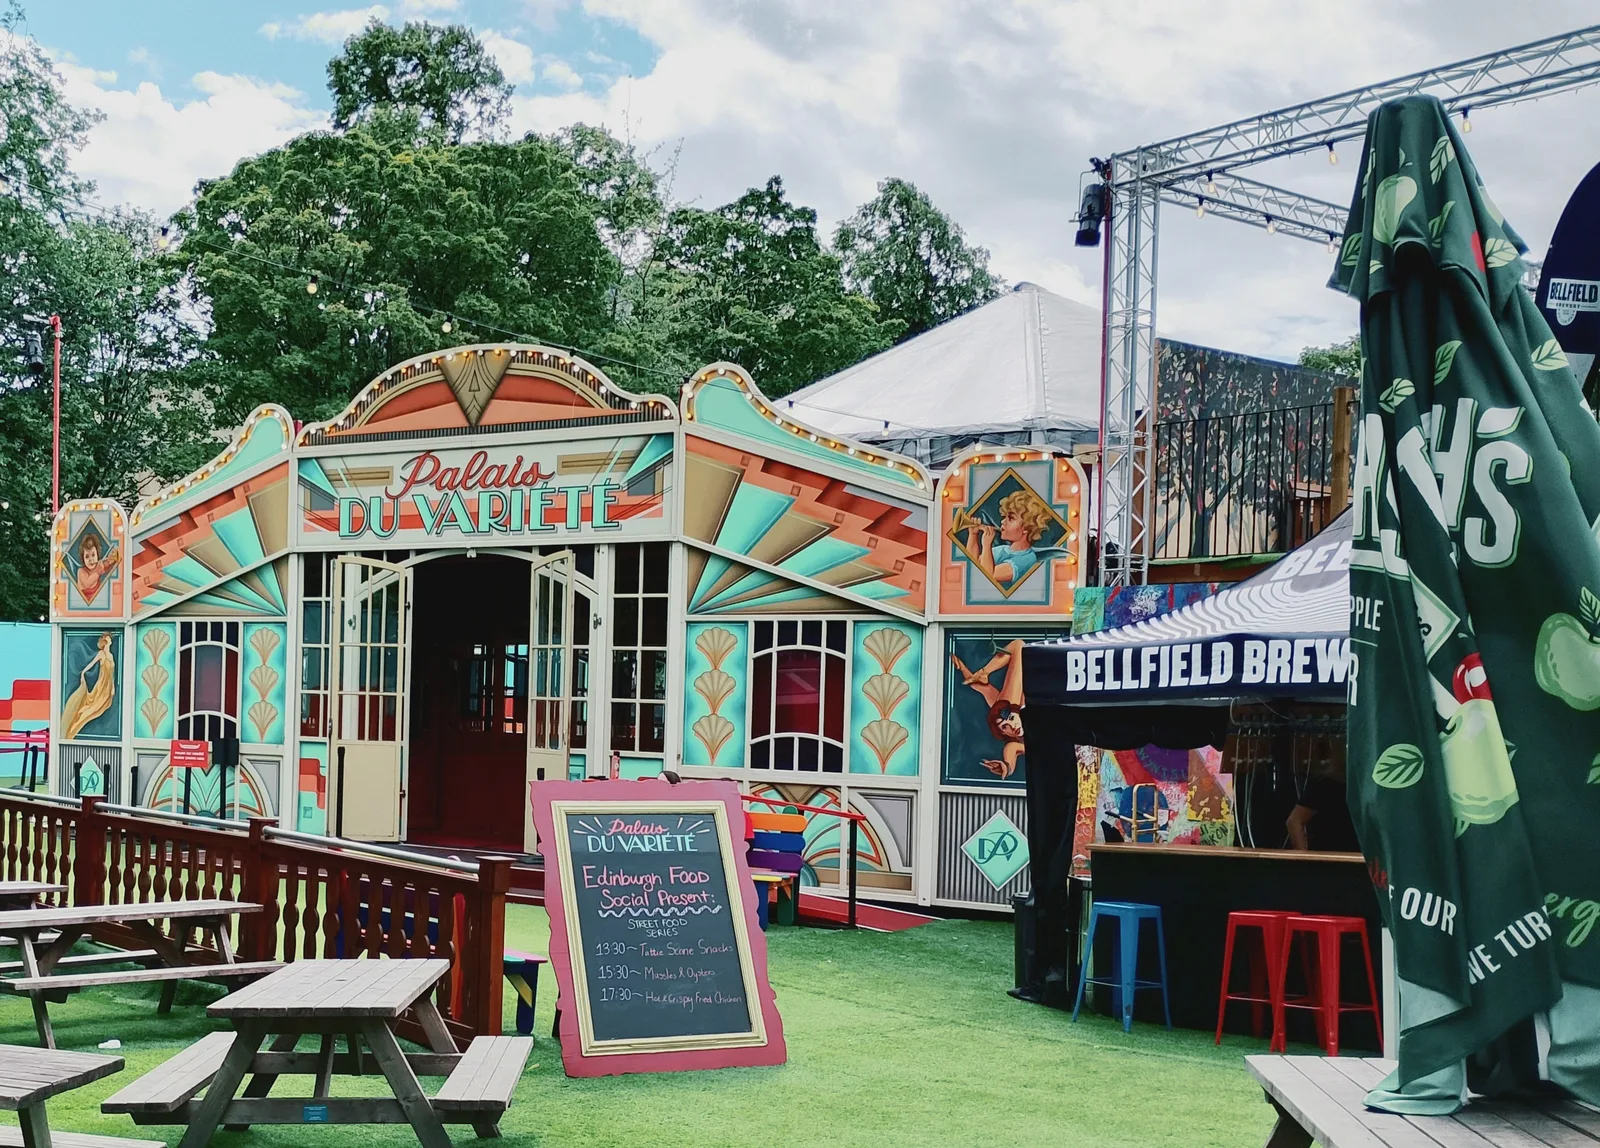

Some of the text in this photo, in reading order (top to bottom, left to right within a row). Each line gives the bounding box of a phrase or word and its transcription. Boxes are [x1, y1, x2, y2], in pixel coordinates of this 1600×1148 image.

[1550, 282, 1598, 303] BELLFIELD
[385, 449, 555, 499] Palais
[338, 478, 622, 540] DU VARIÉTÉ
[1066, 638, 1349, 691] BELLFIELD BREW
[604, 818, 669, 836] Palais
[587, 832, 698, 853] DU VARIÉTÉ
[582, 865, 662, 892] Edinburgh
[600, 889, 649, 910] Social
[1400, 887, 1457, 936] OUR
[627, 918, 688, 930] STREET FOOD
[646, 928, 679, 938] SERIES
[1493, 904, 1552, 957] TUR
